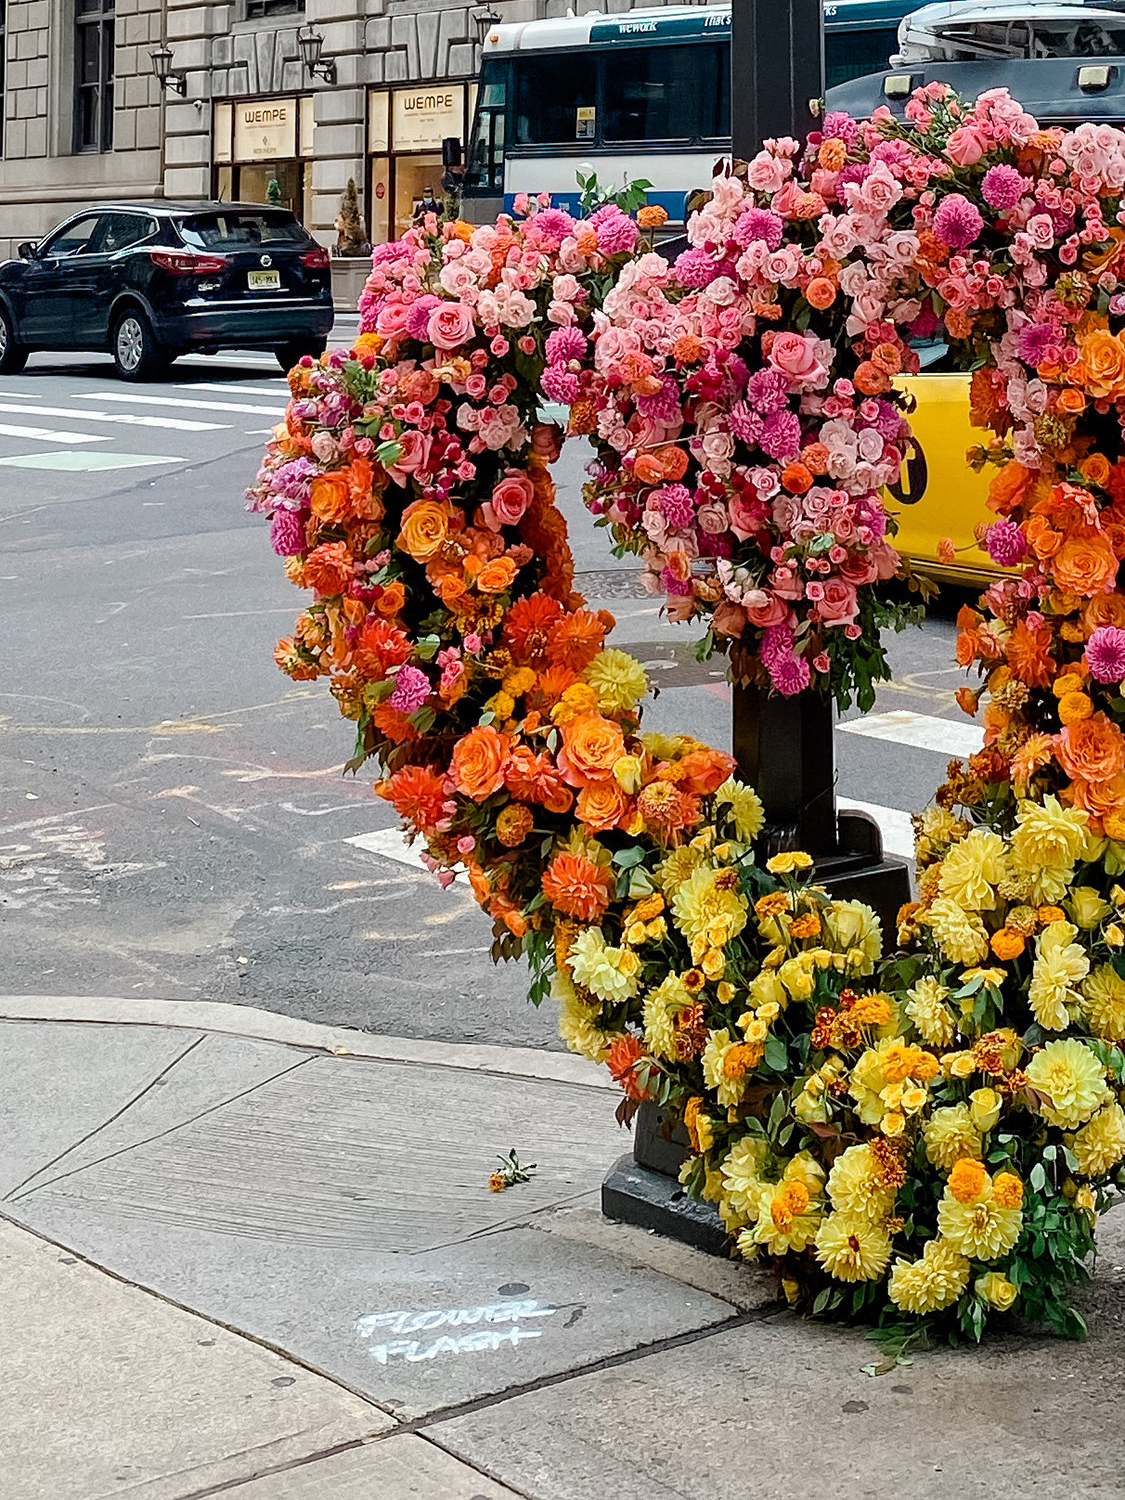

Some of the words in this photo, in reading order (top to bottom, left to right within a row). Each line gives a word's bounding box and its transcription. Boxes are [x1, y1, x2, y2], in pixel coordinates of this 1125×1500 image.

[618, 21, 658, 34] wework
[403, 94, 453, 111] WEMPE
[244, 108, 287, 123] WEMPE
